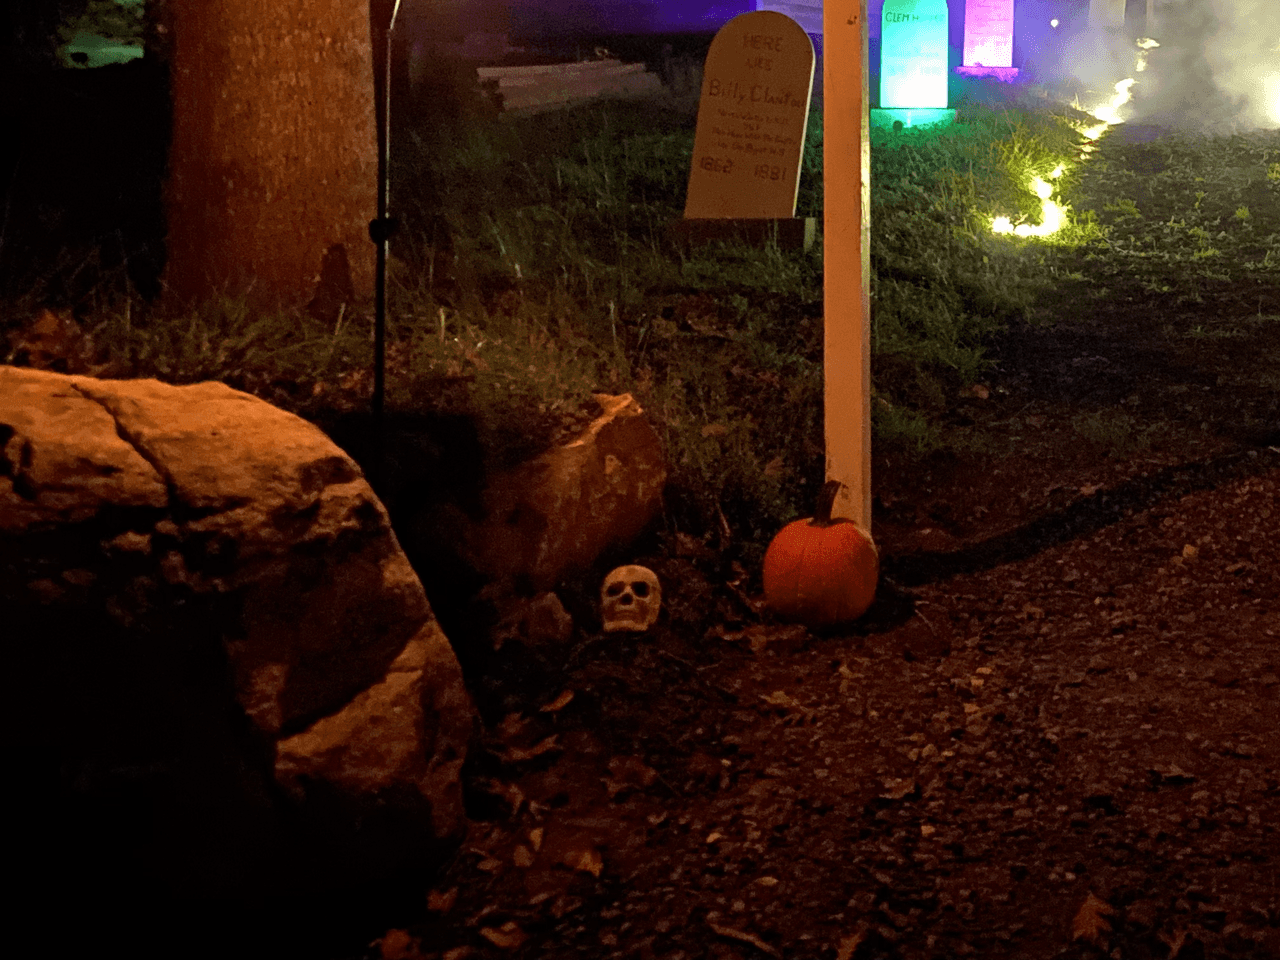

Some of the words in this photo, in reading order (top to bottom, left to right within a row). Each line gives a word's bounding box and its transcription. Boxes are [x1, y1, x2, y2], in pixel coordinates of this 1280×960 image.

[742, 34, 783, 53] HERE
[708, 79, 747, 105] Billy
[753, 163, 787, 181] 1881
